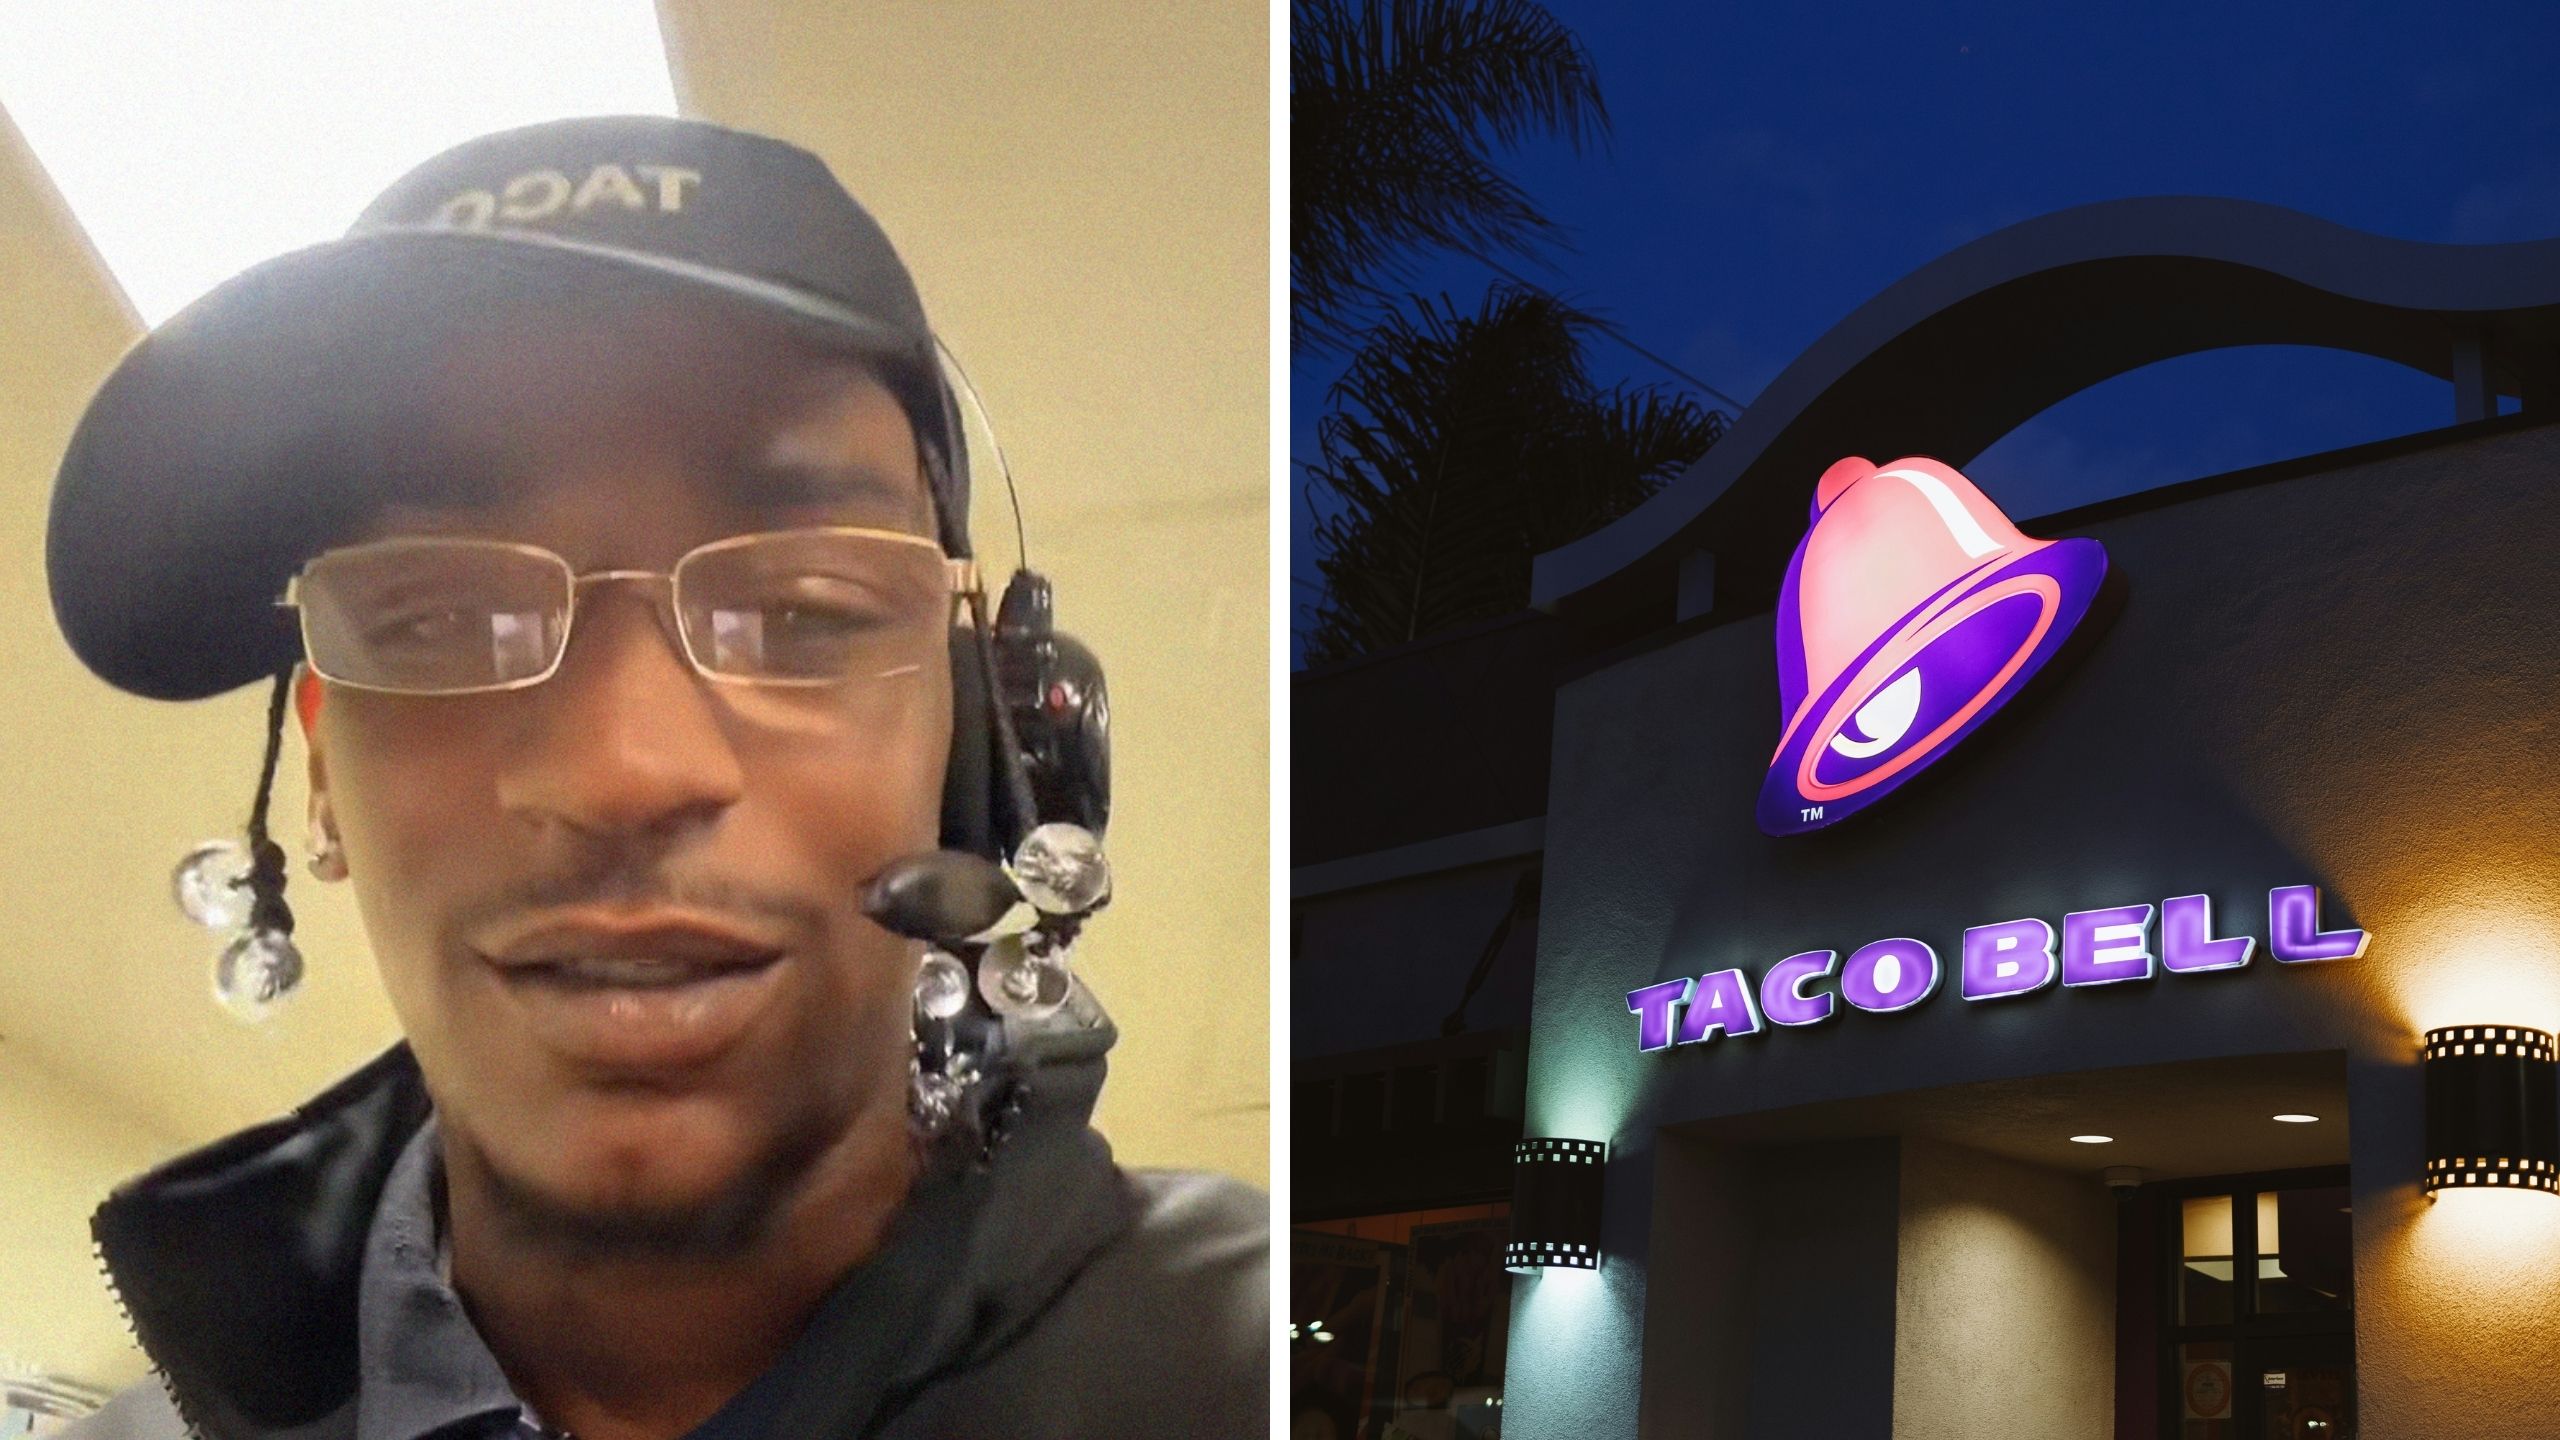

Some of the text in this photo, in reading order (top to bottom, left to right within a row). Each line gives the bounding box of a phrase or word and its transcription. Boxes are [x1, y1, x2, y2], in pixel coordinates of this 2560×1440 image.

[1800, 806, 1824, 822] TM
[1625, 884, 2373, 1053] TACO BELL
